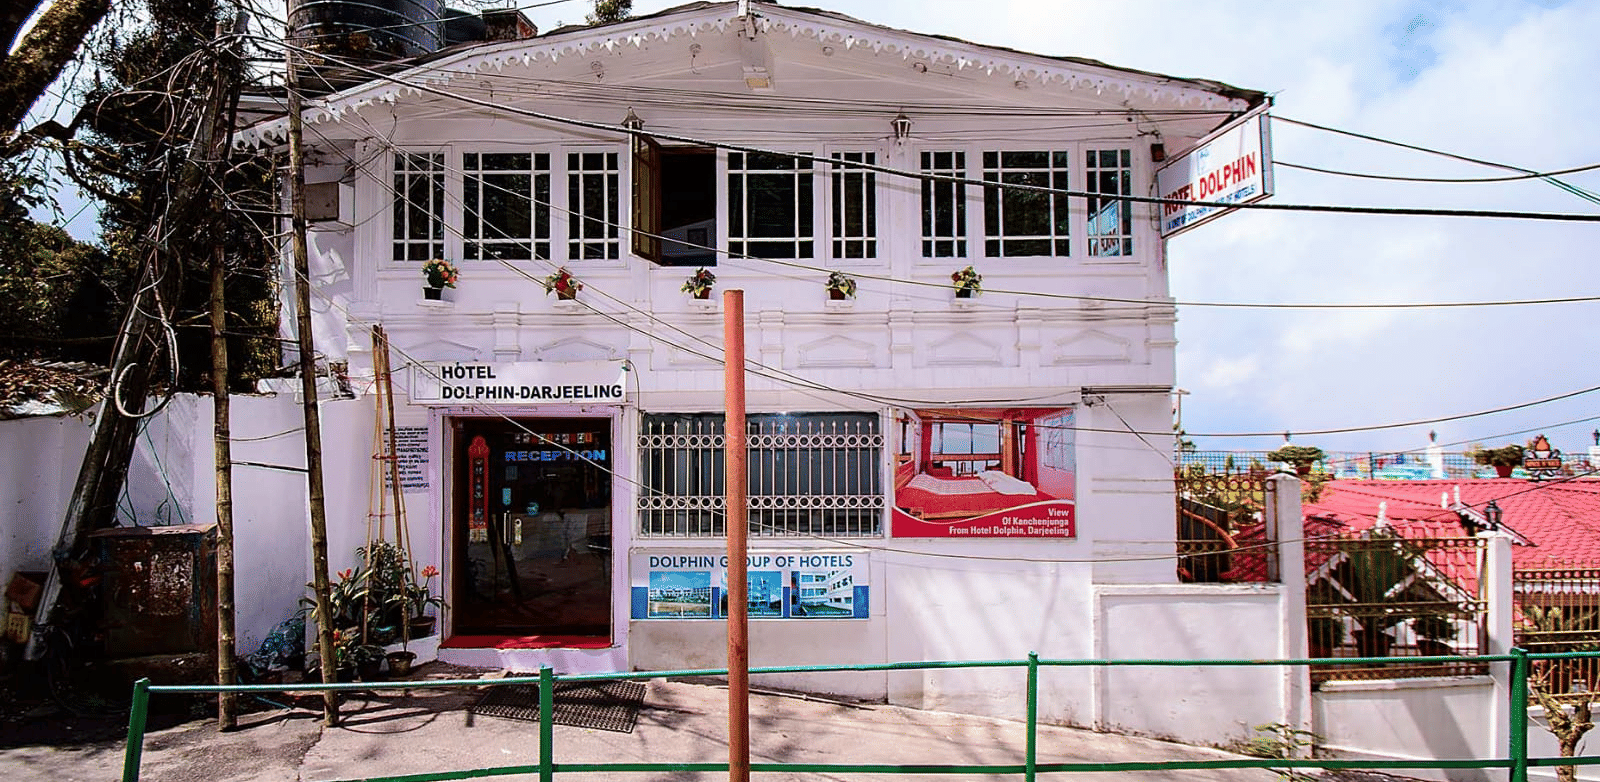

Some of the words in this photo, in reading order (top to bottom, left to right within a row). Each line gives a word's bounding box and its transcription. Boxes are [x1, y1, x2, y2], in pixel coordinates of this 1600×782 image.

[1164, 183, 1197, 217] HOTEL
[1200, 151, 1256, 200] DOLPHIN
[442, 366, 496, 379] HOTEL
[442, 385, 623, 399] DOLPHIN-DARJEELING
[505, 449, 606, 462] RECEPTION
[1048, 508, 1069, 517] View
[1002, 517, 1011, 526] Of
[949, 526, 969, 535] From
[970, 526, 992, 535] Hotel
[1028, 526, 1070, 537] Darjeeling
[649, 556, 714, 568] DOLPHIN
[720, 556, 771, 568] GUP
[775, 556, 795, 568] OF
[799, 555, 853, 568] HOTELS
